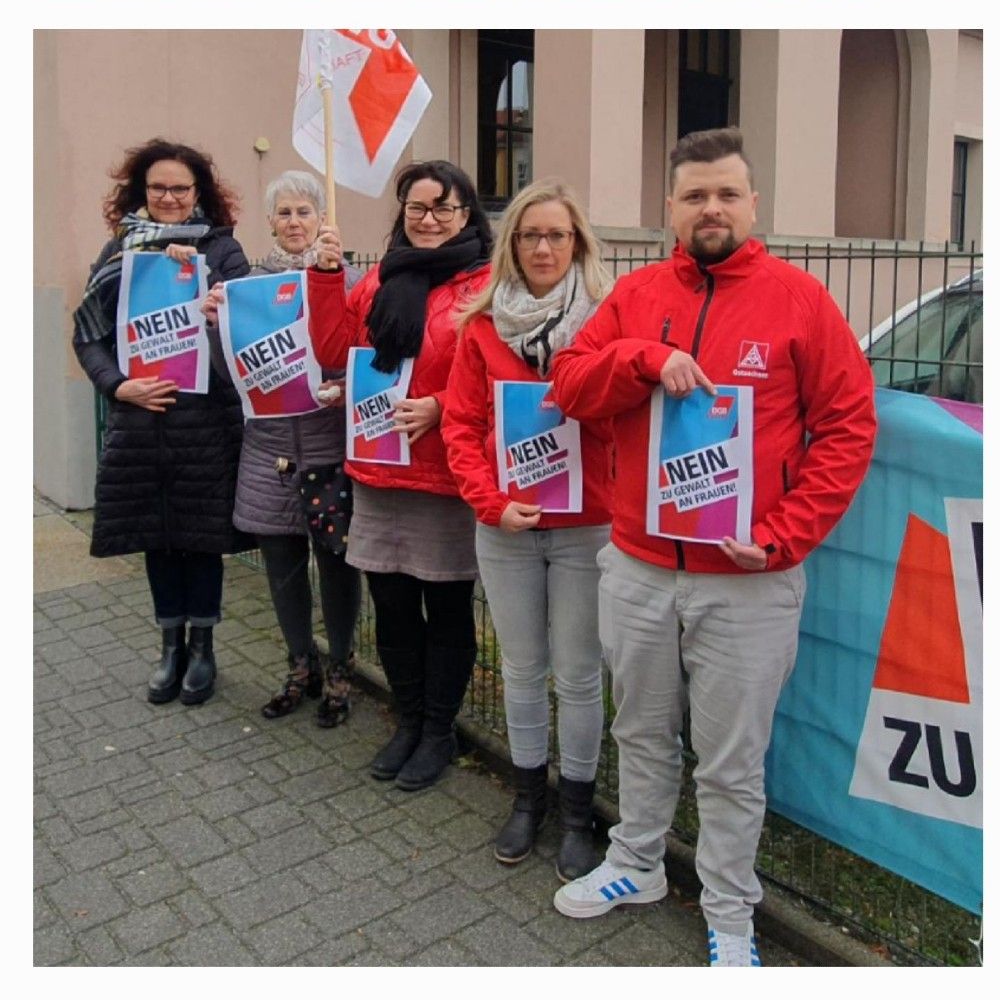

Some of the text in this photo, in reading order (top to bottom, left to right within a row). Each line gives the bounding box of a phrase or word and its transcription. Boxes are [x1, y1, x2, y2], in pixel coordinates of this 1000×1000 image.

[133, 305, 191, 339] NEIN
[240, 328, 297, 372] NEIN
[357, 392, 391, 421] NEIN
[511, 432, 559, 466] NEIN
[666, 445, 729, 485] NEIN
[661, 478, 711, 500] ZU GEWALT
[679, 483, 737, 508] AN FRAUEN!
[883, 716, 977, 798] ZU
